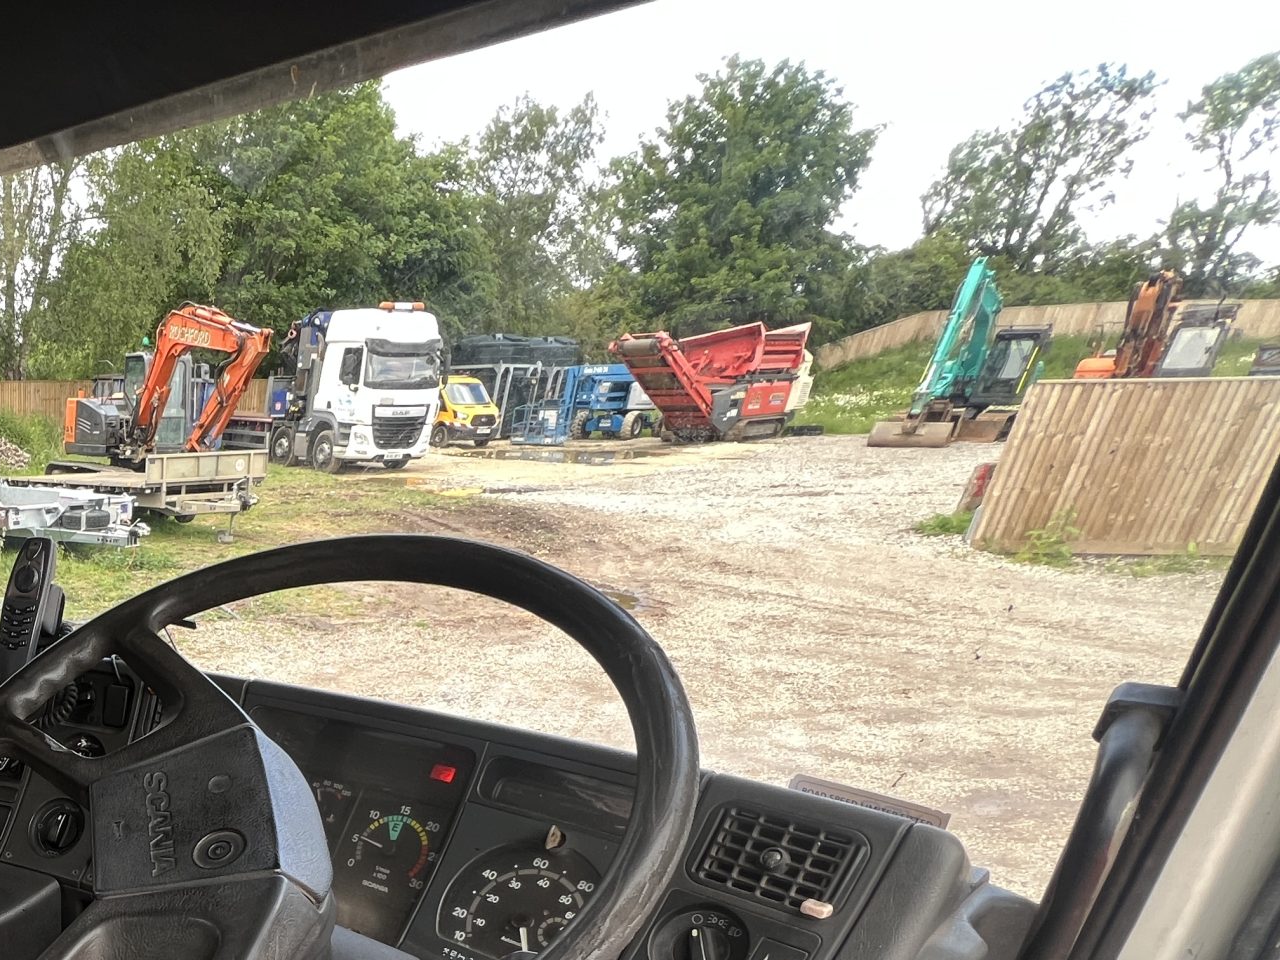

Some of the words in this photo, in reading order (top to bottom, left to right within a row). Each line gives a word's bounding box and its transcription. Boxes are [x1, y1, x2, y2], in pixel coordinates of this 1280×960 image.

[369, 810, 380, 820] 10
[400, 805, 411, 815] 15
[144, 772, 176, 877] SCANIA
[391, 823, 400, 832] E
[425, 821, 440, 832] 20
[352, 834, 360, 842] 5
[347, 859, 355, 867] 0
[532, 858, 549, 869] 60
[482, 869, 497, 880] 40
[362, 879, 389, 893] SCANIA
[508, 880, 521, 890] 30
[536, 880, 550, 888] 40
[577, 880, 594, 892] 80
[487, 894, 499, 903] 20
[558, 895, 572, 905] 50
[452, 907, 467, 918] 20
[454, 930, 466, 941] 10
